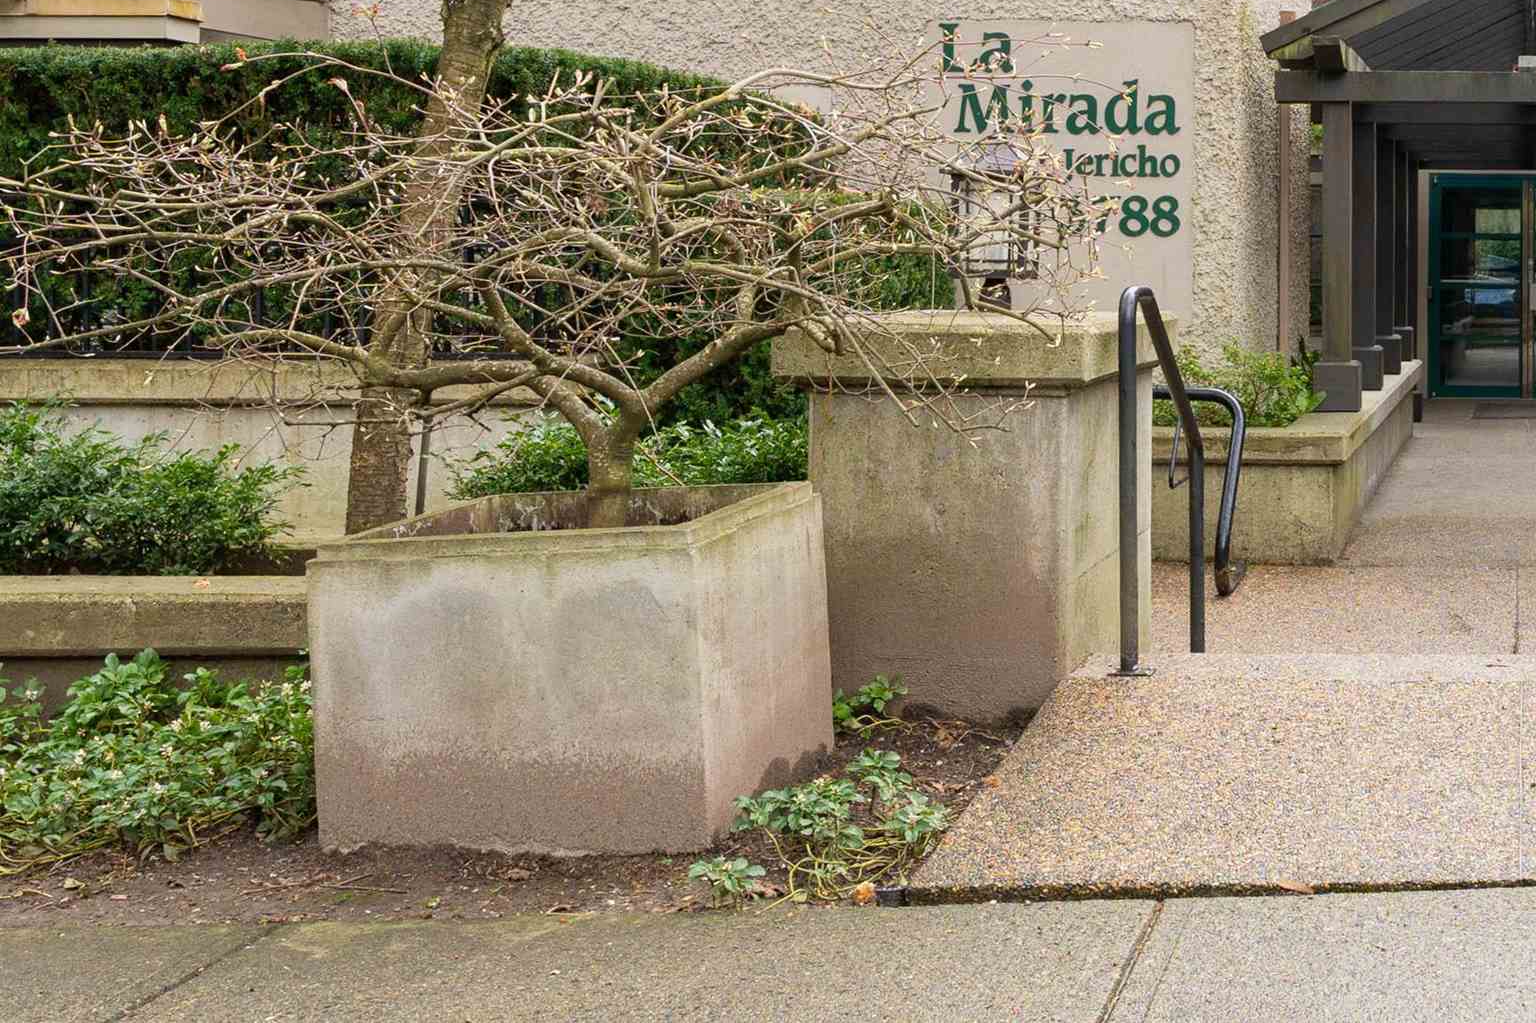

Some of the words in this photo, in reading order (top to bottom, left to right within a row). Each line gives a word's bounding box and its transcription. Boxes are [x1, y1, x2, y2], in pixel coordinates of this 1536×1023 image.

[939, 22, 1016, 73] La
[953, 79, 1181, 135] Mirada
[1063, 144, 1181, 181] Jericho
